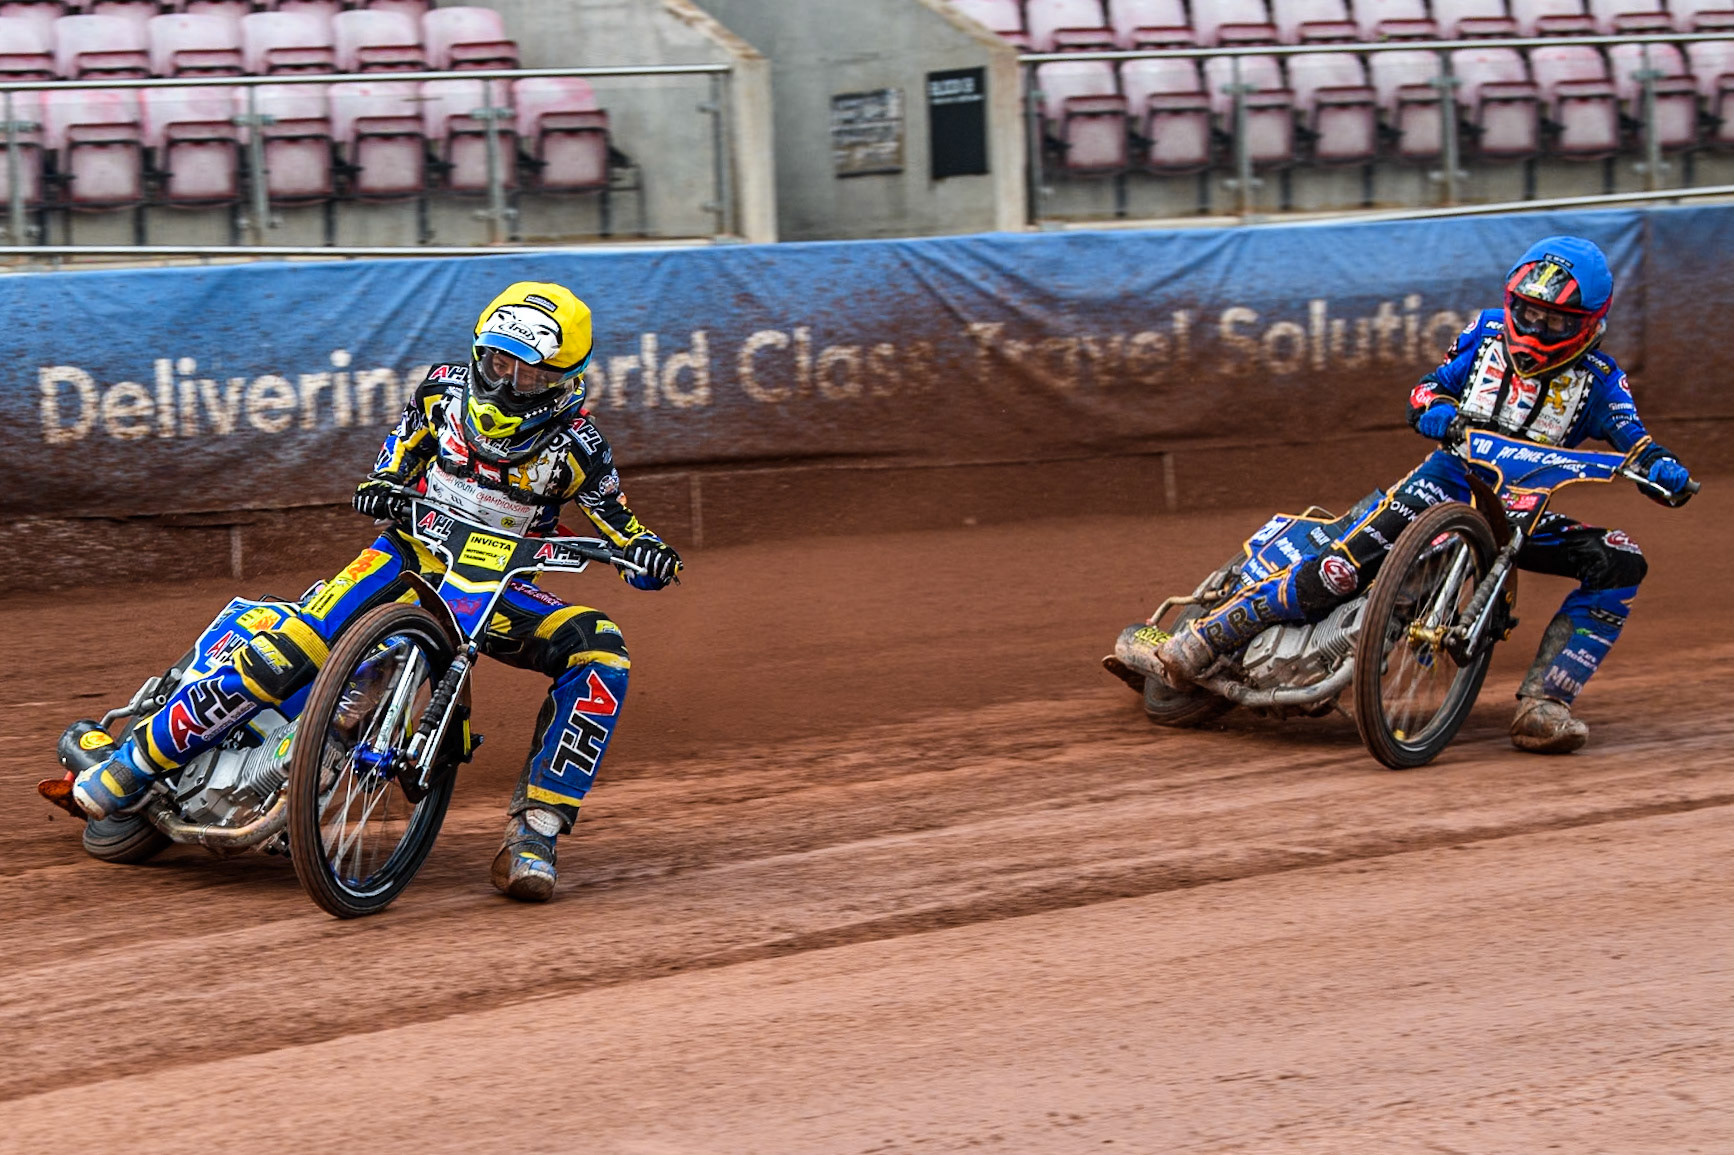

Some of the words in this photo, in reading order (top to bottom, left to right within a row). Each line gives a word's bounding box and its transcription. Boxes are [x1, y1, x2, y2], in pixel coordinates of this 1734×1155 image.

[582, 330, 713, 408] orld
[738, 326, 940, 402] Class
[1219, 296, 1480, 376] Solutio
[1513, 448, 1544, 463] BIKE
[454, 478, 476, 495] YOUTH
[476, 491, 531, 514] CHAMPIONSHIP
[417, 511, 454, 536] AHL
[470, 536, 512, 551] INVICTA
[169, 675, 249, 753] AHL
[550, 669, 618, 776] AHL
